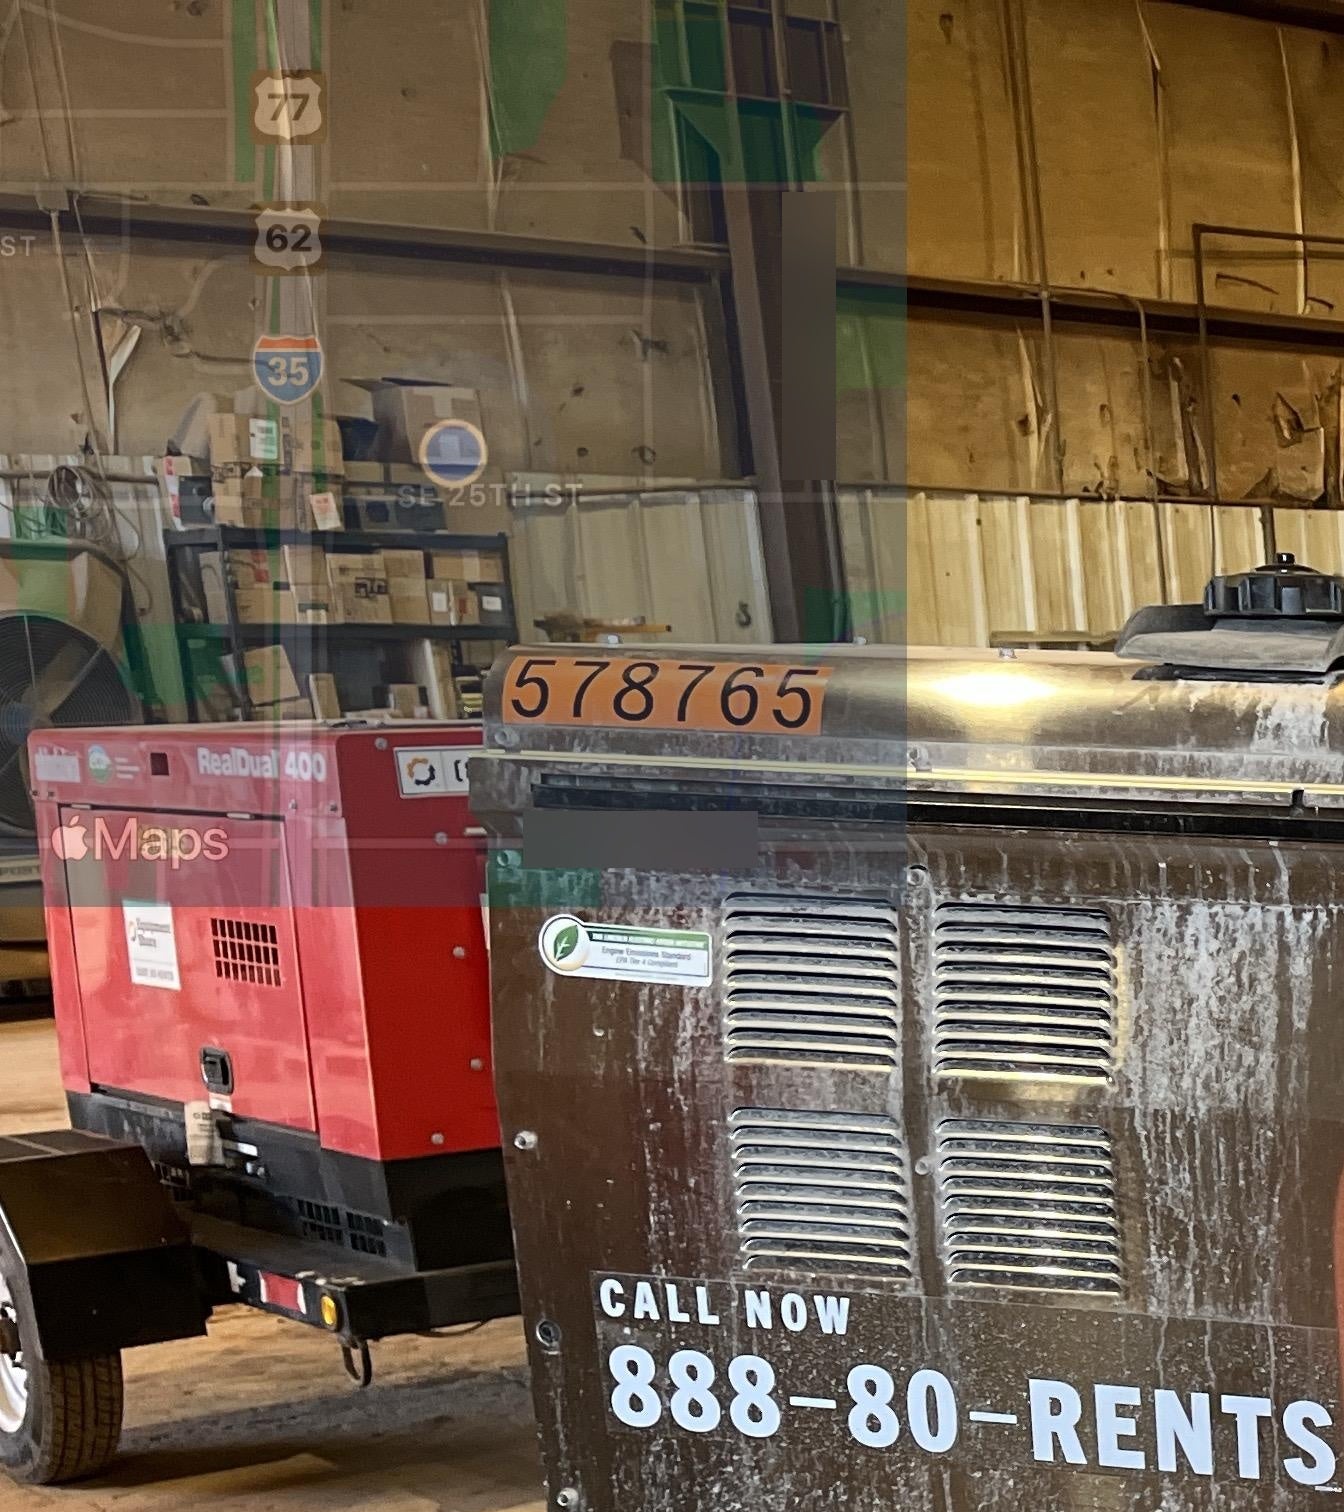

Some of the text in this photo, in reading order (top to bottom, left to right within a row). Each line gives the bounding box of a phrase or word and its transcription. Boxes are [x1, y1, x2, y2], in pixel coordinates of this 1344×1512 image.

[510, 658, 820, 730] 578765
[196, 748, 327, 782] RealDual 400
[599, 1278, 851, 1336] CALL NOW
[608, 1344, 1338, 1487] 888-80-RENTS
